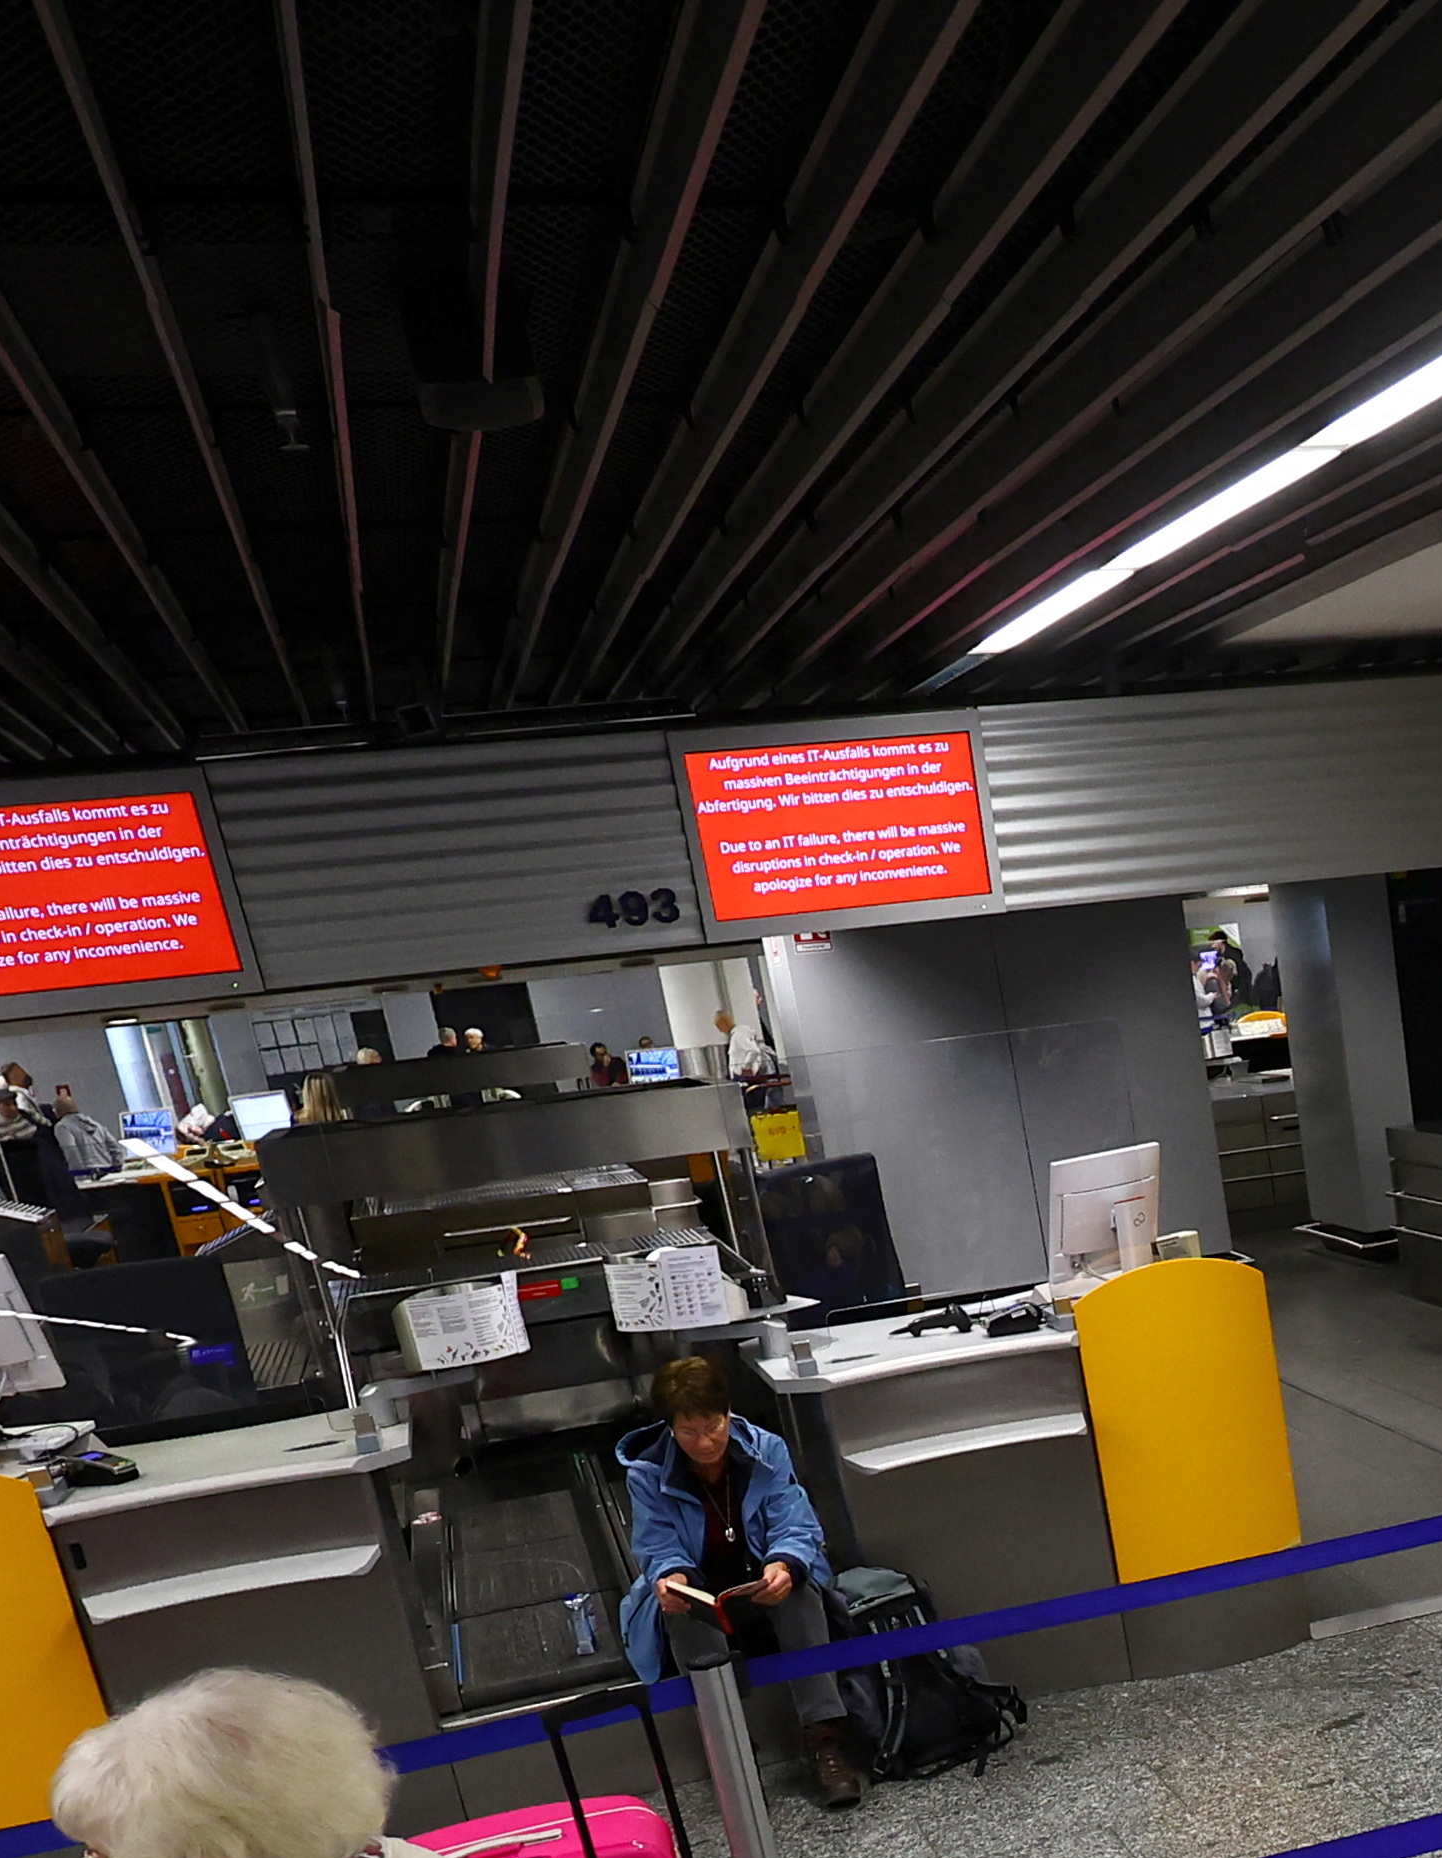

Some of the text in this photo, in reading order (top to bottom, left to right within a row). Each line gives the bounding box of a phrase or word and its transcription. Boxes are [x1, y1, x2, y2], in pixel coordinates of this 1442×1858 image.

[709, 741, 949, 772] Aufgrund eines IT-Ausfalls kommt es zu
[723, 761, 942, 790] massiven Beeinträchtigungen in der
[71, 805, 129, 821] kommt
[130, 804, 149, 816] es
[150, 803, 169, 815] zu
[697, 780, 973, 814] Abfertigung. Wir bitten dies zu entschuldigen.
[118, 826, 135, 840] in
[137, 825, 163, 839] der
[719, 821, 966, 854] Due to an IT failure, there will be massive
[39, 856, 73, 871] dies
[74, 856, 94, 868] zu
[96, 846, 205, 866] entschuldigen.
[732, 857, 803, 874] disruptions
[803, 854, 817, 867] in
[818, 850, 869, 866] check-in
[878, 844, 940, 863] operation.
[940, 841, 961, 854] We
[753, 864, 948, 895] apologize for any inconvenience.
[46, 902, 88, 917] there
[89, 896, 117, 912] will
[117, 896, 139, 910] be
[141, 891, 201, 908] massive
[589, 888, 680, 928] 493
[0, 930, 18, 944] in
[19, 924, 83, 942] check-in
[94, 916, 171, 937] operation.
[171, 913, 198, 927] We
[17, 950, 40, 965] for
[44, 949, 71, 964] any
[73, 939, 184, 960] inconvenience.
